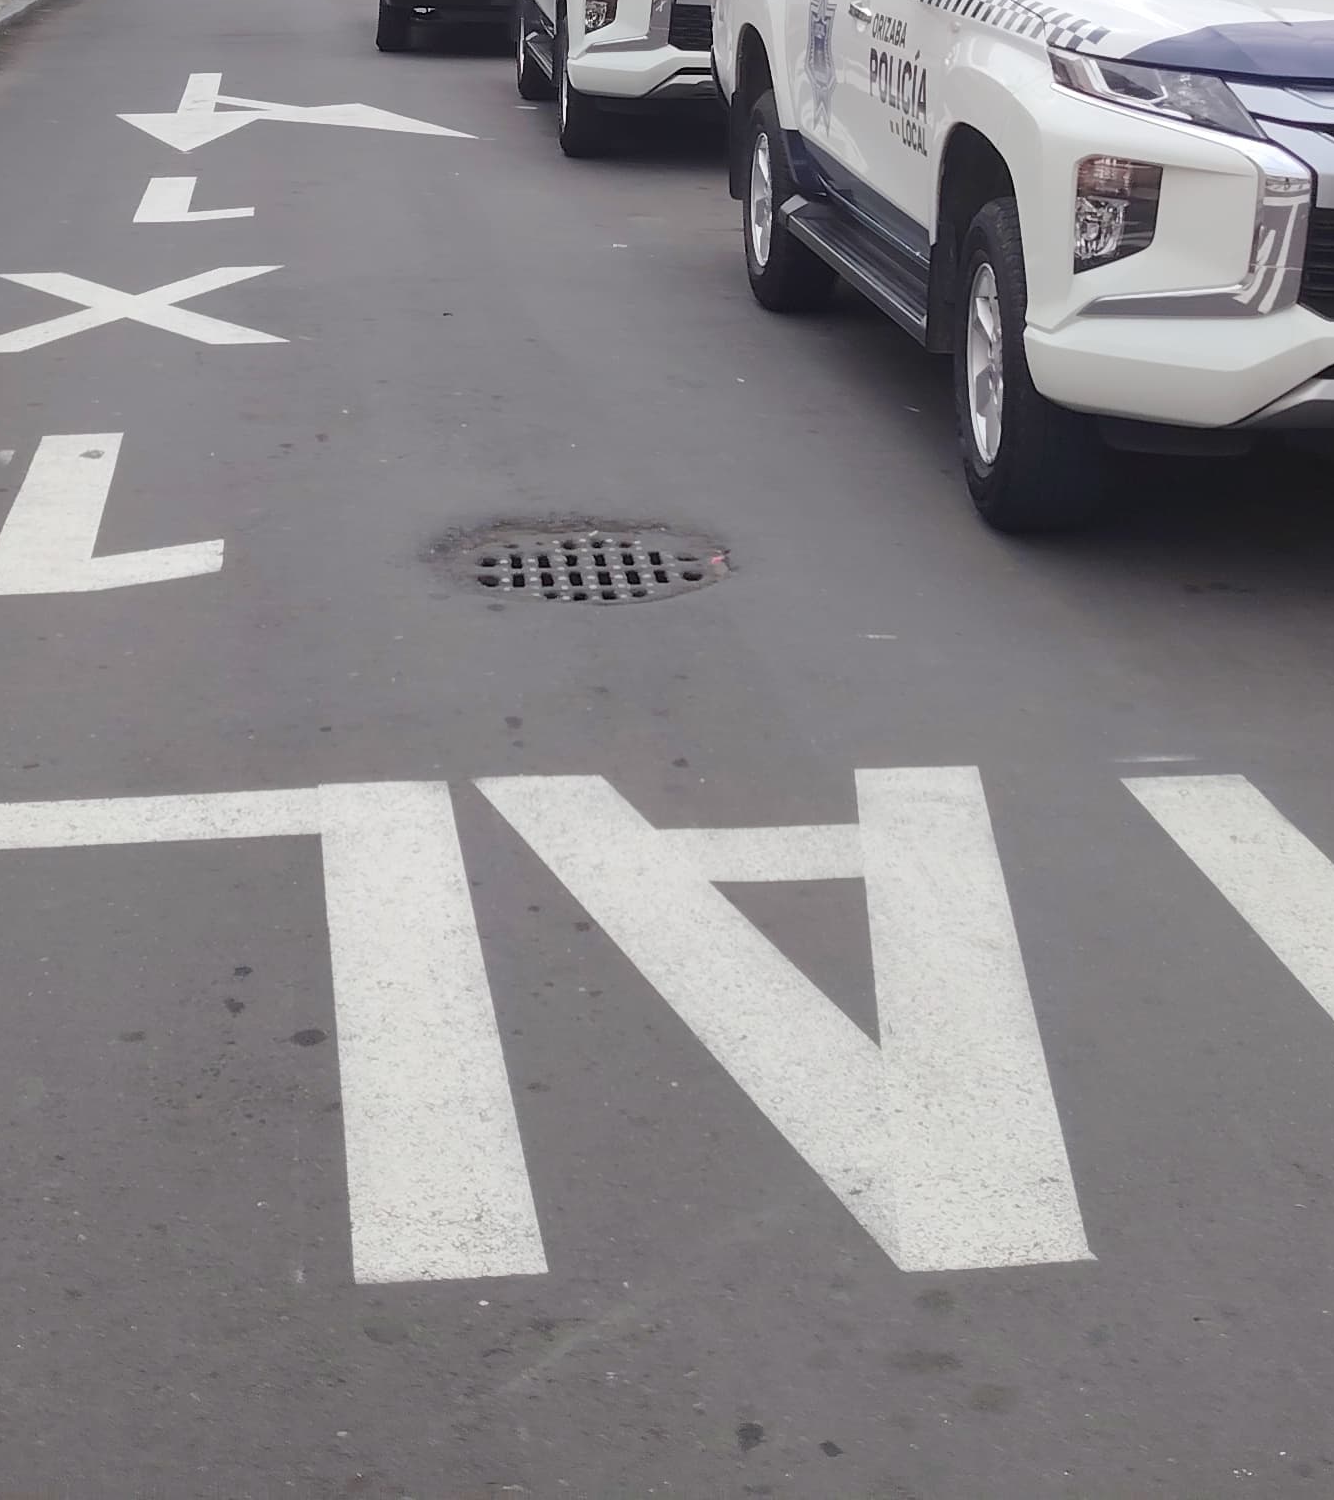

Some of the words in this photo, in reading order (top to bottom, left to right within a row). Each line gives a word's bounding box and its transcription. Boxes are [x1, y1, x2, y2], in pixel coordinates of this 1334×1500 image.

[871, 13, 908, 49] ORIZABA
[869, 48, 928, 125] POLICÍA
[901, 115, 928, 157] LOCAL
